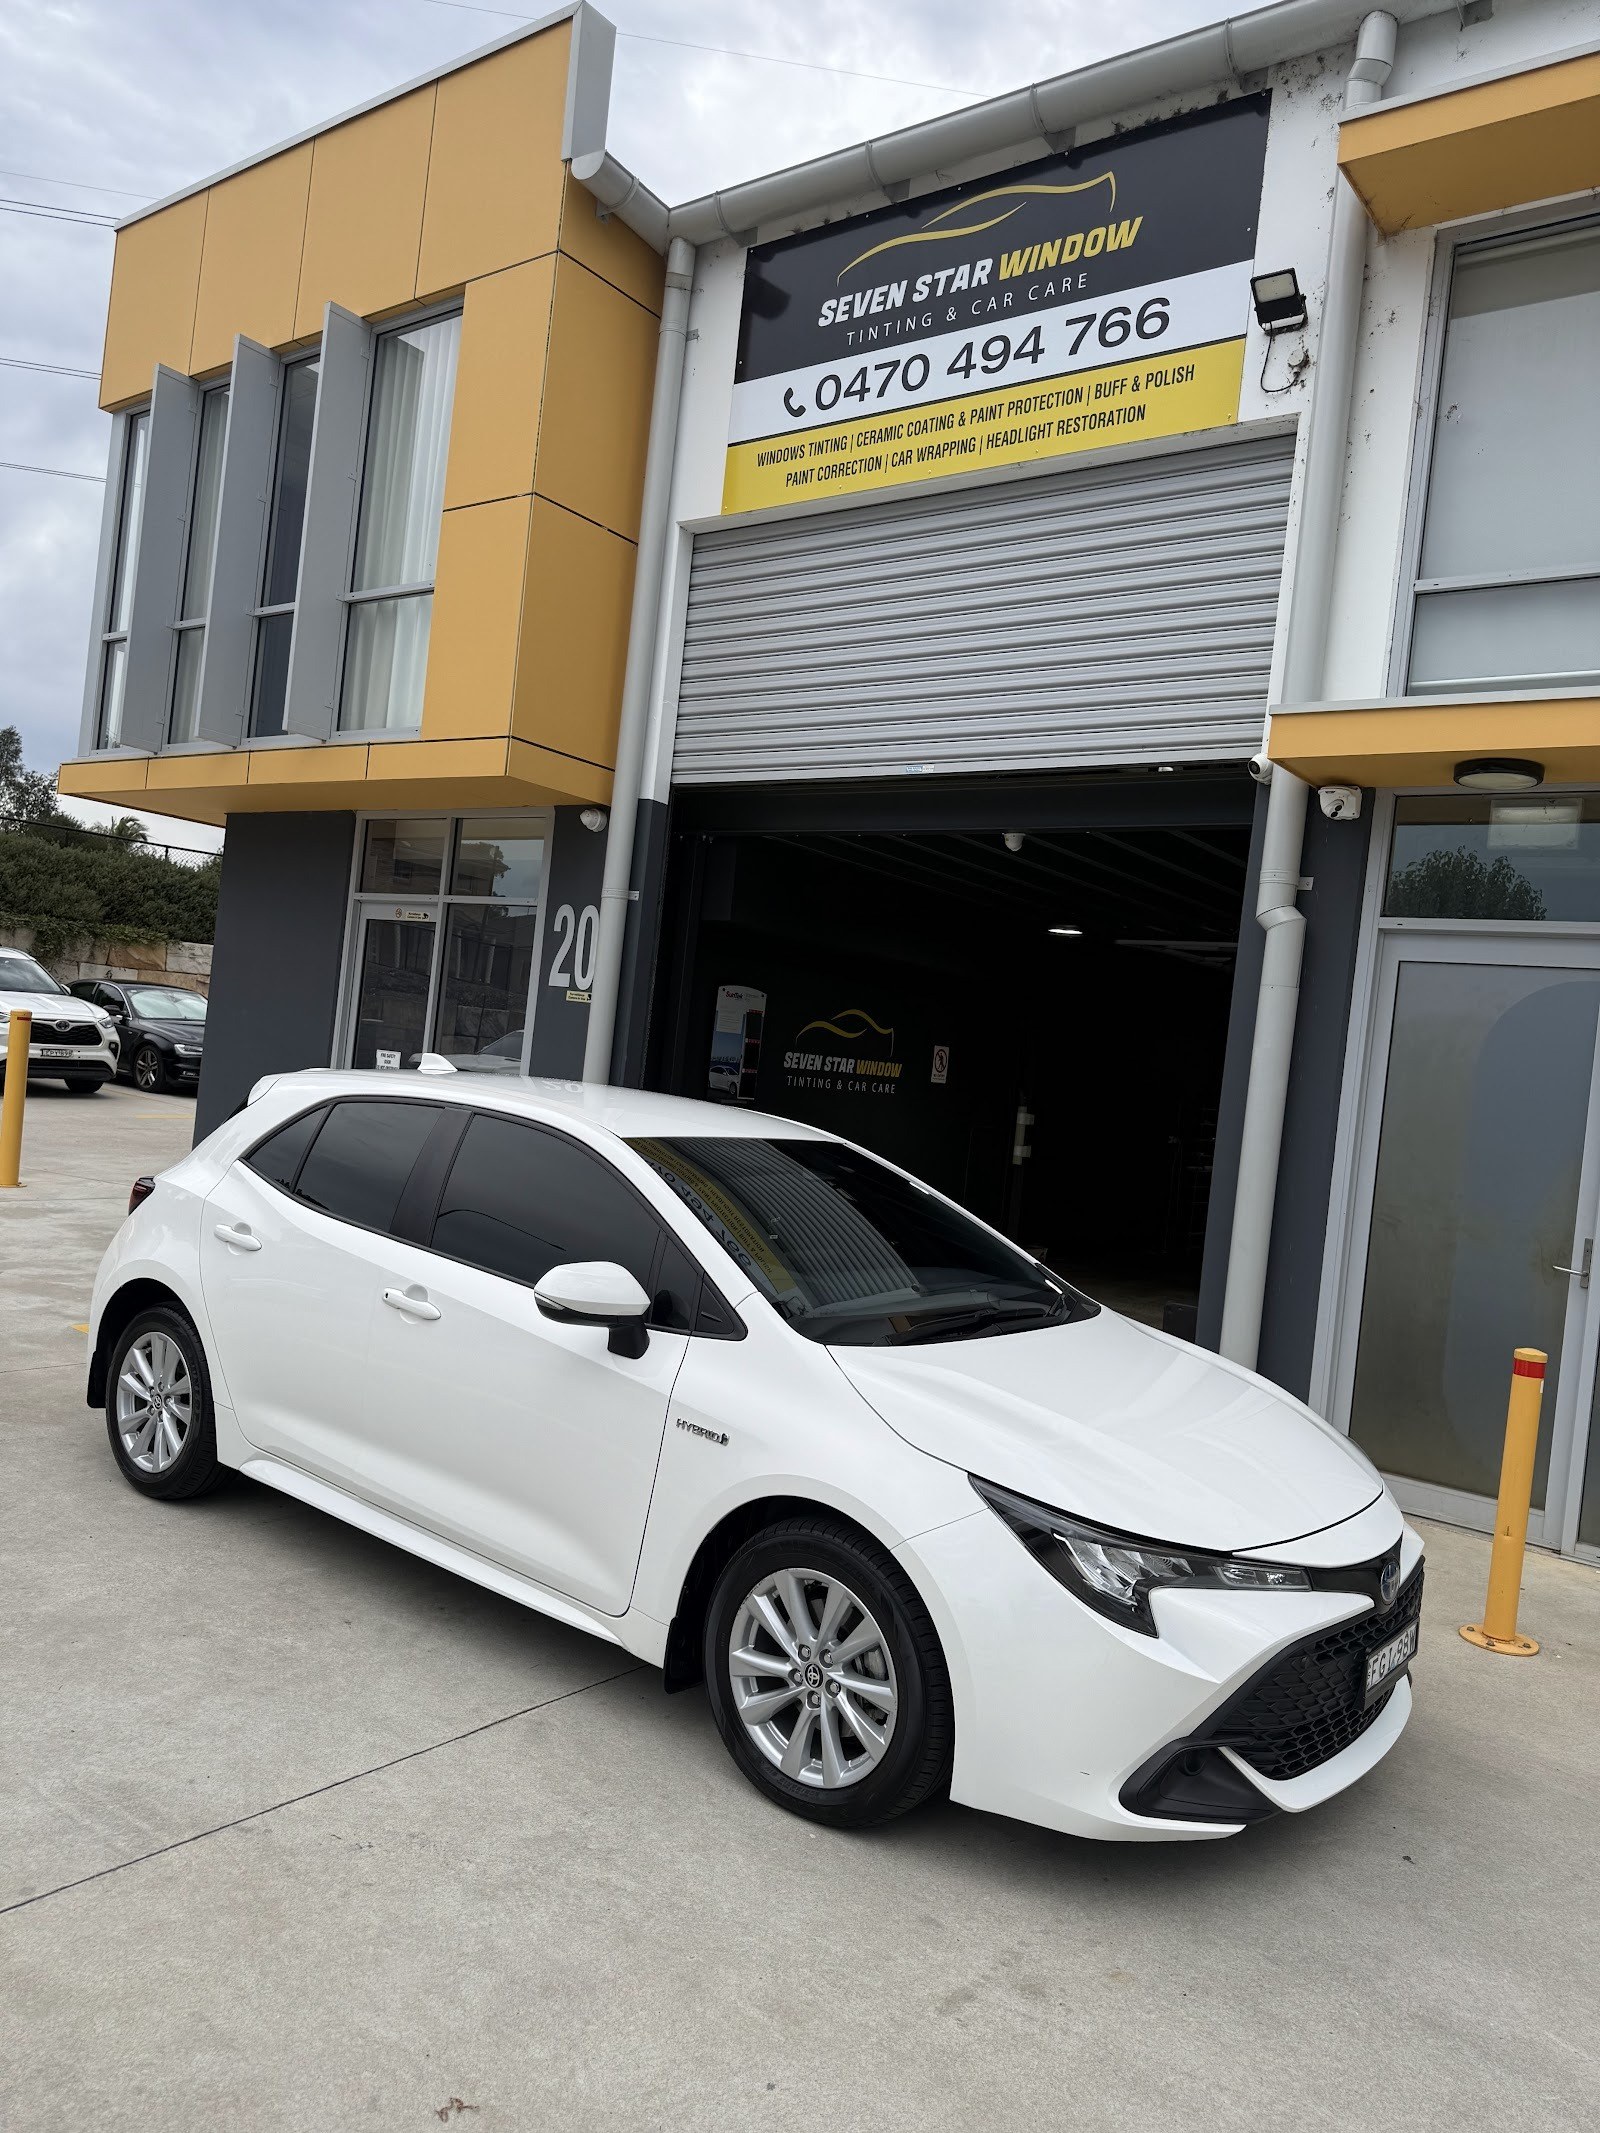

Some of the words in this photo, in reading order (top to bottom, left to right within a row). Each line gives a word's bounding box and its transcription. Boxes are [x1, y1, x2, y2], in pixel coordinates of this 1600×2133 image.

[818, 280, 908, 327] SEVEN
[912, 258, 994, 303] STAR
[998, 216, 1144, 281] WINDOW
[847, 312, 932, 346] TINTING
[946, 306, 957, 322] &
[971, 292, 1013, 315] CAR
[1028, 273, 1088, 300] CARE
[815, 353, 930, 411] 0470
[946, 325, 1045, 380] 494
[1065, 297, 1171, 357] 766
[757, 444, 806, 467] WINDOWS
[808, 434, 848, 456] TINTING
[856, 424, 904, 448] CERAMIC
[907, 413, 955, 438] COATING
[958, 411, 966, 428] &
[970, 403, 1004, 426] PAINT
[1007, 386, 1084, 418] PROTECTION
[1094, 377, 1129, 400] BUFF
[1132, 375, 1140, 393] &
[1145, 364, 1195, 390] POLISH
[785, 468, 816, 488] PAINT
[817, 455, 883, 481] CORRECTION
[891, 449, 913, 468] CAR
[916, 437, 976, 463] WRAPPING
[986, 421, 1054, 450] HEADLIGHT
[1056, 404, 1146, 437] RESTORATION
[549, 904, 600, 990] 20
[783, 1052, 823, 1071] SEVEN
[824, 1056, 855, 1074] STAR
[856, 1059, 902, 1077] WINDOW
[787, 1076, 831, 1089] TINTING
[837, 1080, 842, 1090] &
[848, 1081, 867, 1092] CAR
[872, 1083, 896, 1094] CARE
[676, 1418, 720, 1444] HYBRID
